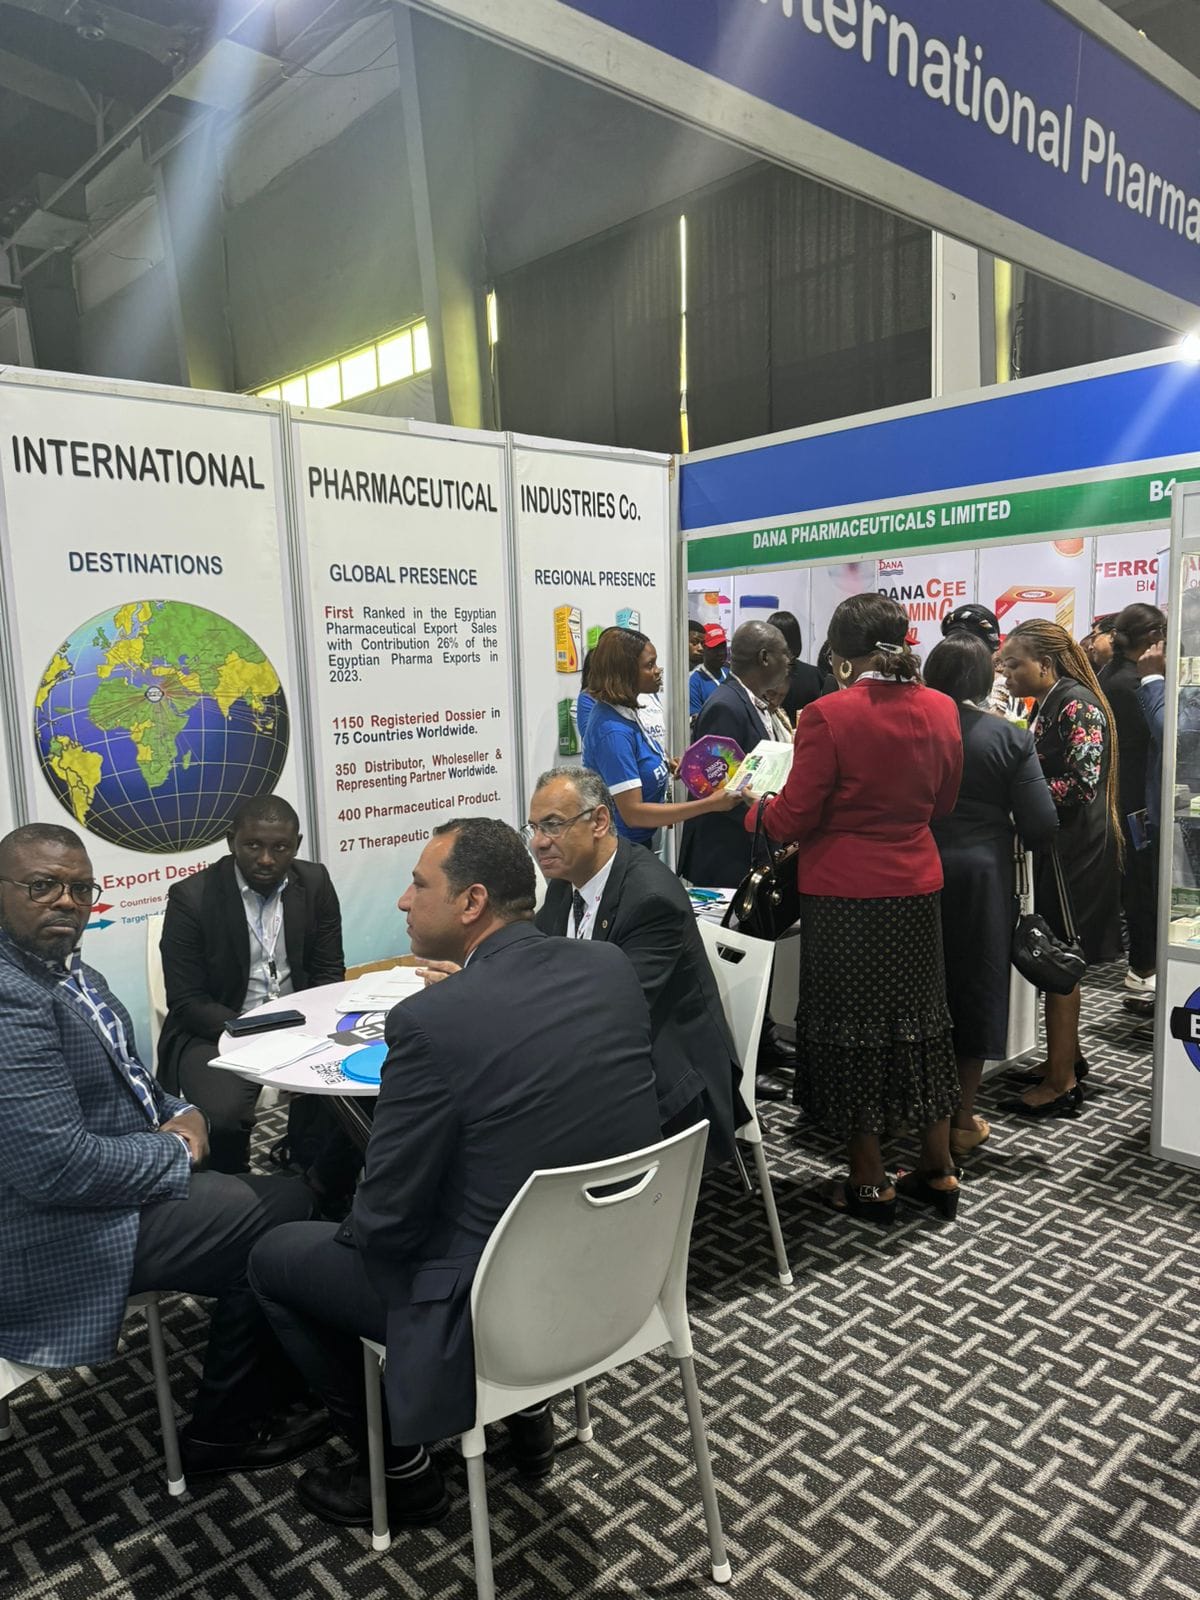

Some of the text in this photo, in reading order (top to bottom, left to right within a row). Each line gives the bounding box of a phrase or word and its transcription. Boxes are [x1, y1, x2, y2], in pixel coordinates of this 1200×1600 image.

[12, 435, 641, 521] INTERNATIONAL PHARMACEUTICAL INDUSTRIES Co.
[753, 500, 1011, 549] DANA PHARMACEUTICALS LIMITED
[69, 551, 223, 575] DESTINATIONS
[329, 563, 478, 585] GLOBAL PRESENCE
[535, 569, 656, 587] REGIONAL PRESENCE
[325, 606, 497, 622] First Ranked in the Egyptian
[326, 622, 497, 636] Pharmaceutical Export Sales
[327, 636, 498, 650] with Contribution 26% of the
[329, 651, 498, 669] Egyptian Pharma Exports in
[329, 670, 362, 682] 2023.
[332, 707, 501, 730] 1150 Registeried Dossier in
[333, 723, 478, 745] 75 Countries Worldwide.
[335, 748, 502, 776] 350 Distributor, Wholeseller &
[336, 764, 498, 792] Representing Partner Worldwide.
[338, 790, 501, 822] 400 Pharmaceutical Product.
[339, 829, 429, 852] 27 Therapeutic
[103, 861, 213, 889] Export Desti
[120, 894, 162, 908] Countries
